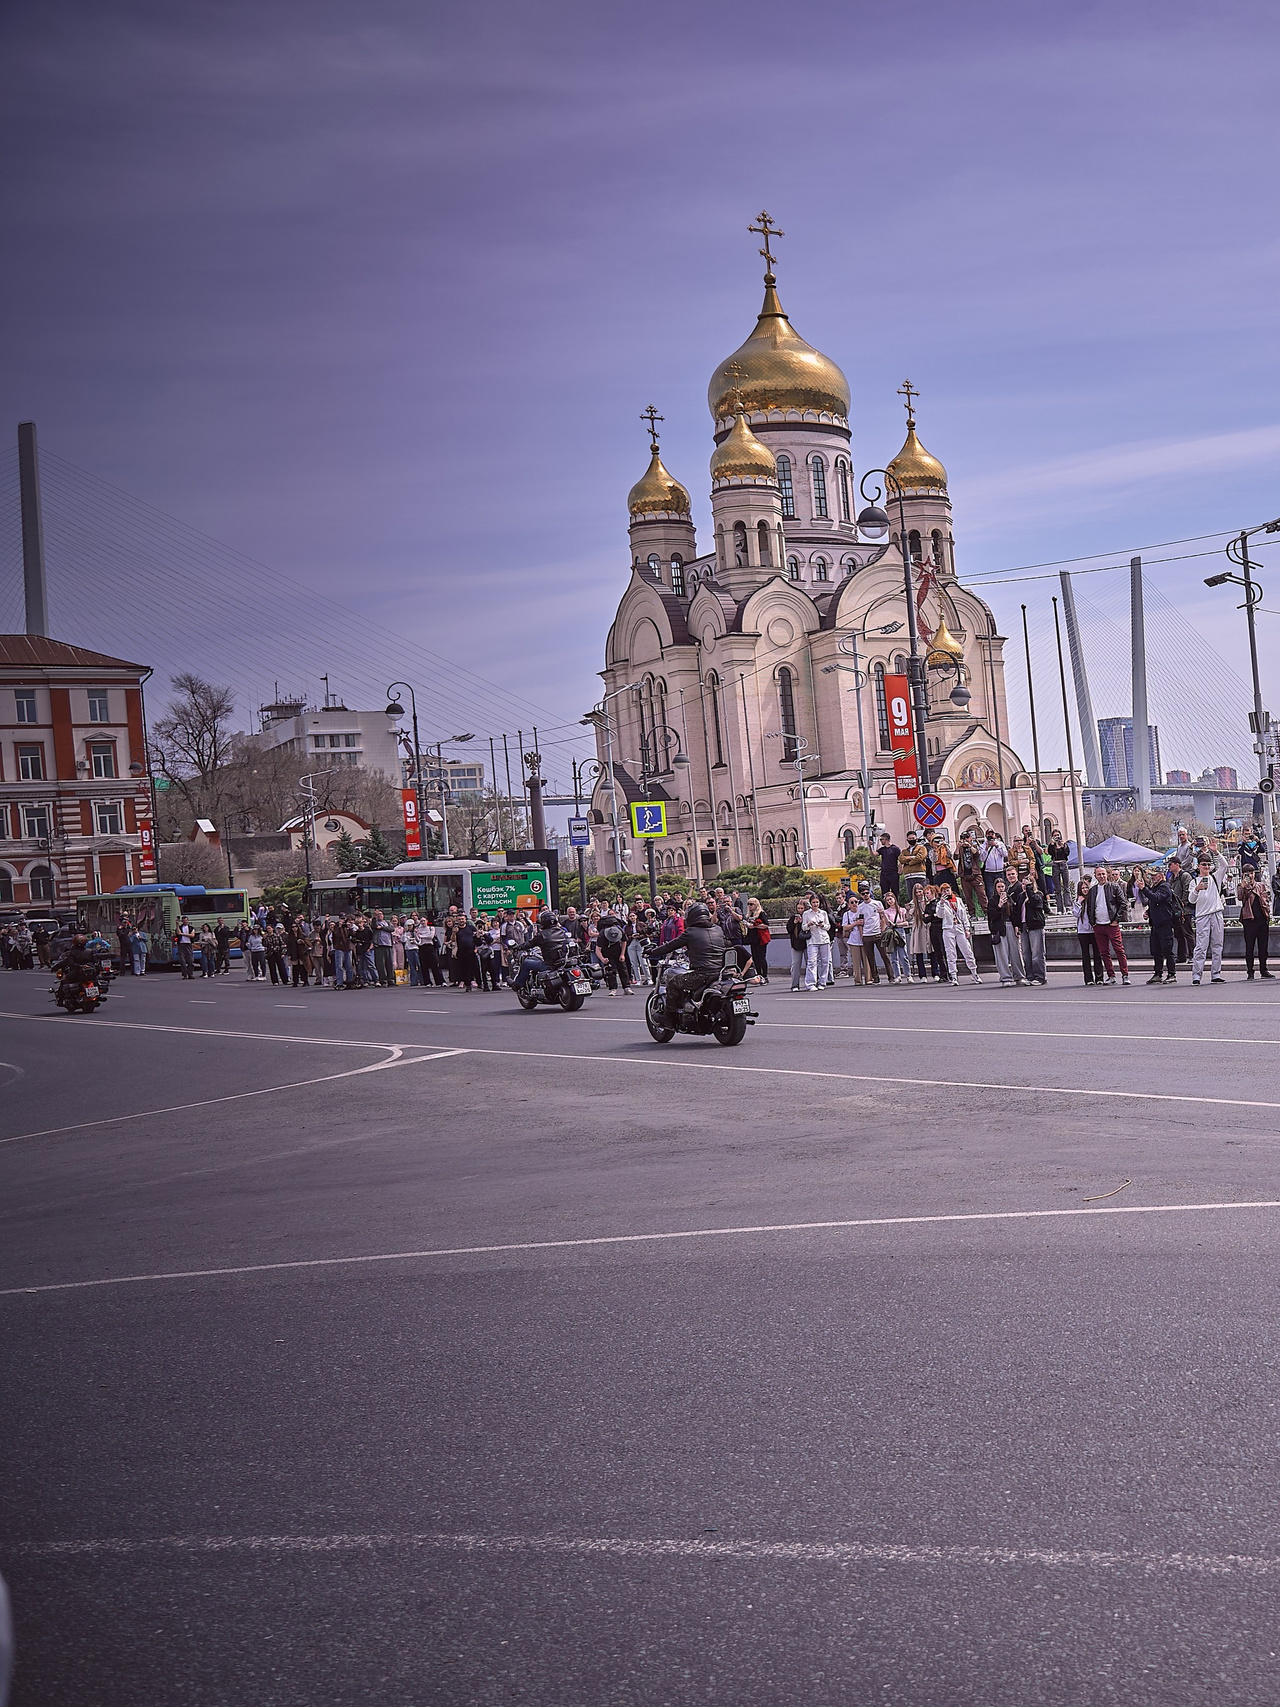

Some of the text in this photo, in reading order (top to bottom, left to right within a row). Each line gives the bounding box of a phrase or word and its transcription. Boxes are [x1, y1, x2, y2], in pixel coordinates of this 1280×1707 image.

[891, 697, 908, 726] 9
[894, 728, 909, 736] МАЯ
[405, 801, 415, 817] 9
[142, 830, 150, 842] 9
[476, 885, 505, 893] Кешбэк
[483, 891, 508, 900] картой
